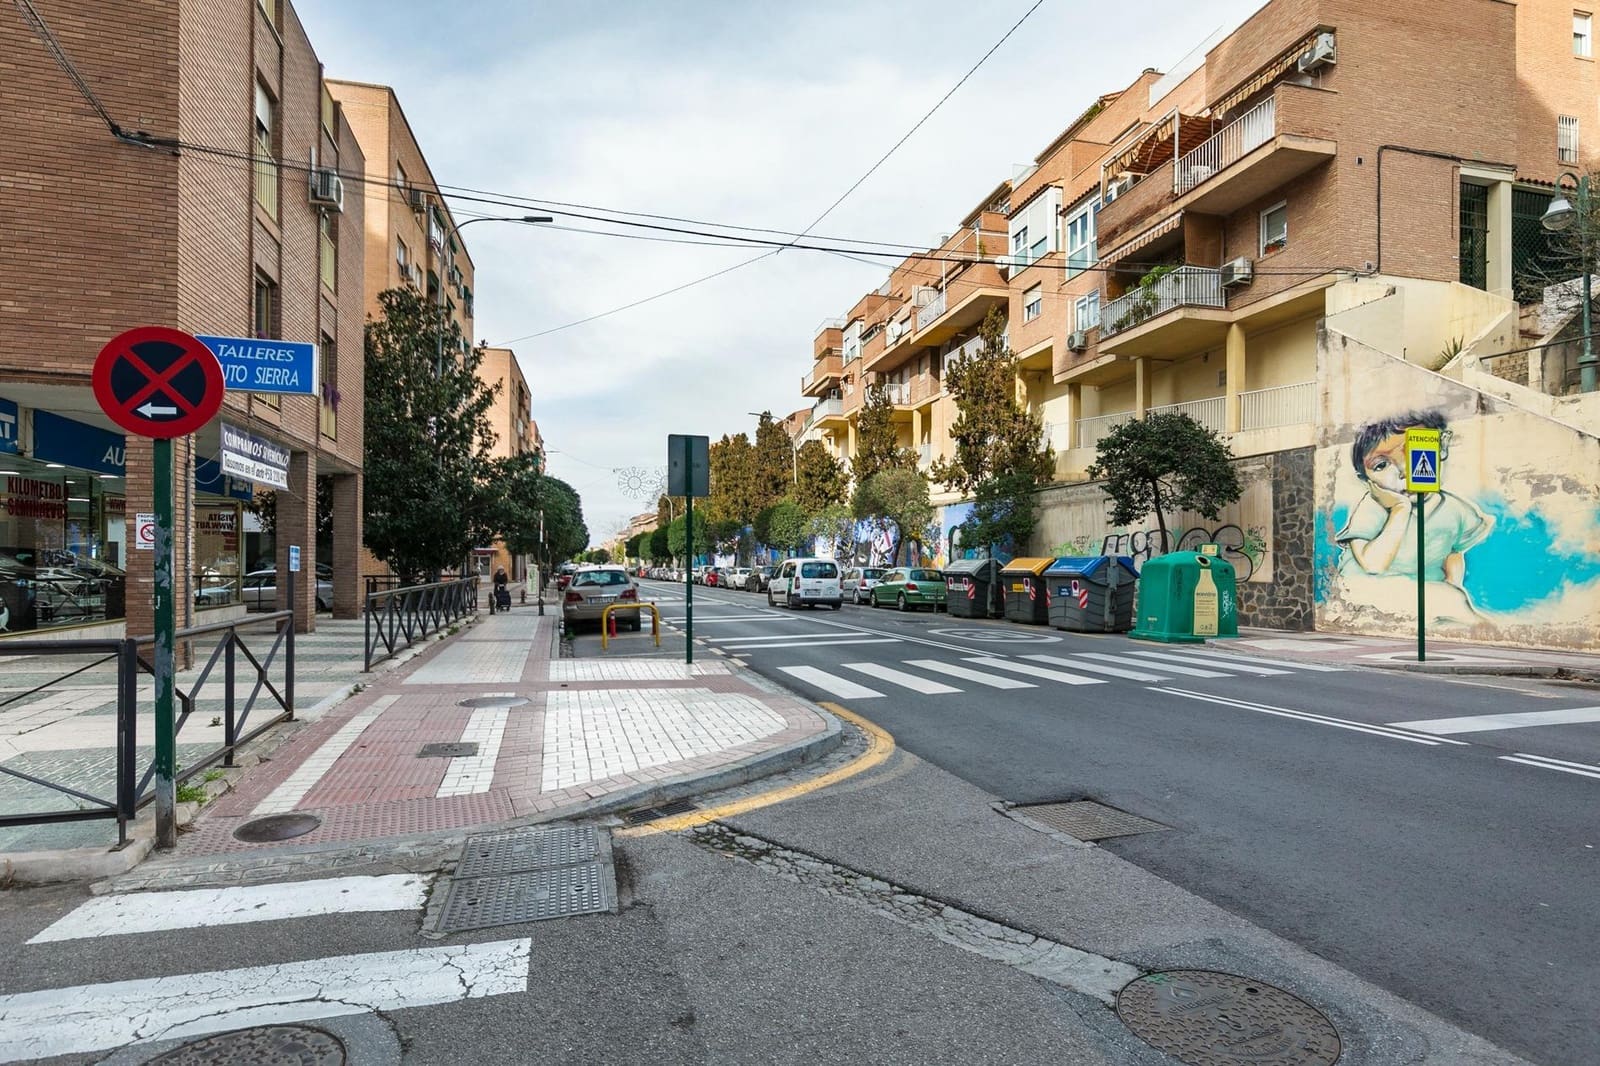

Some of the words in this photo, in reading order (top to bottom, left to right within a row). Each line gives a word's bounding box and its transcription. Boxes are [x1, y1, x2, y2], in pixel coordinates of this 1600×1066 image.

[217, 344, 295, 362] TALLERES
[221, 363, 248, 383] UTO
[254, 366, 299, 386] SIERRA
[102, 445, 126, 466] AU
